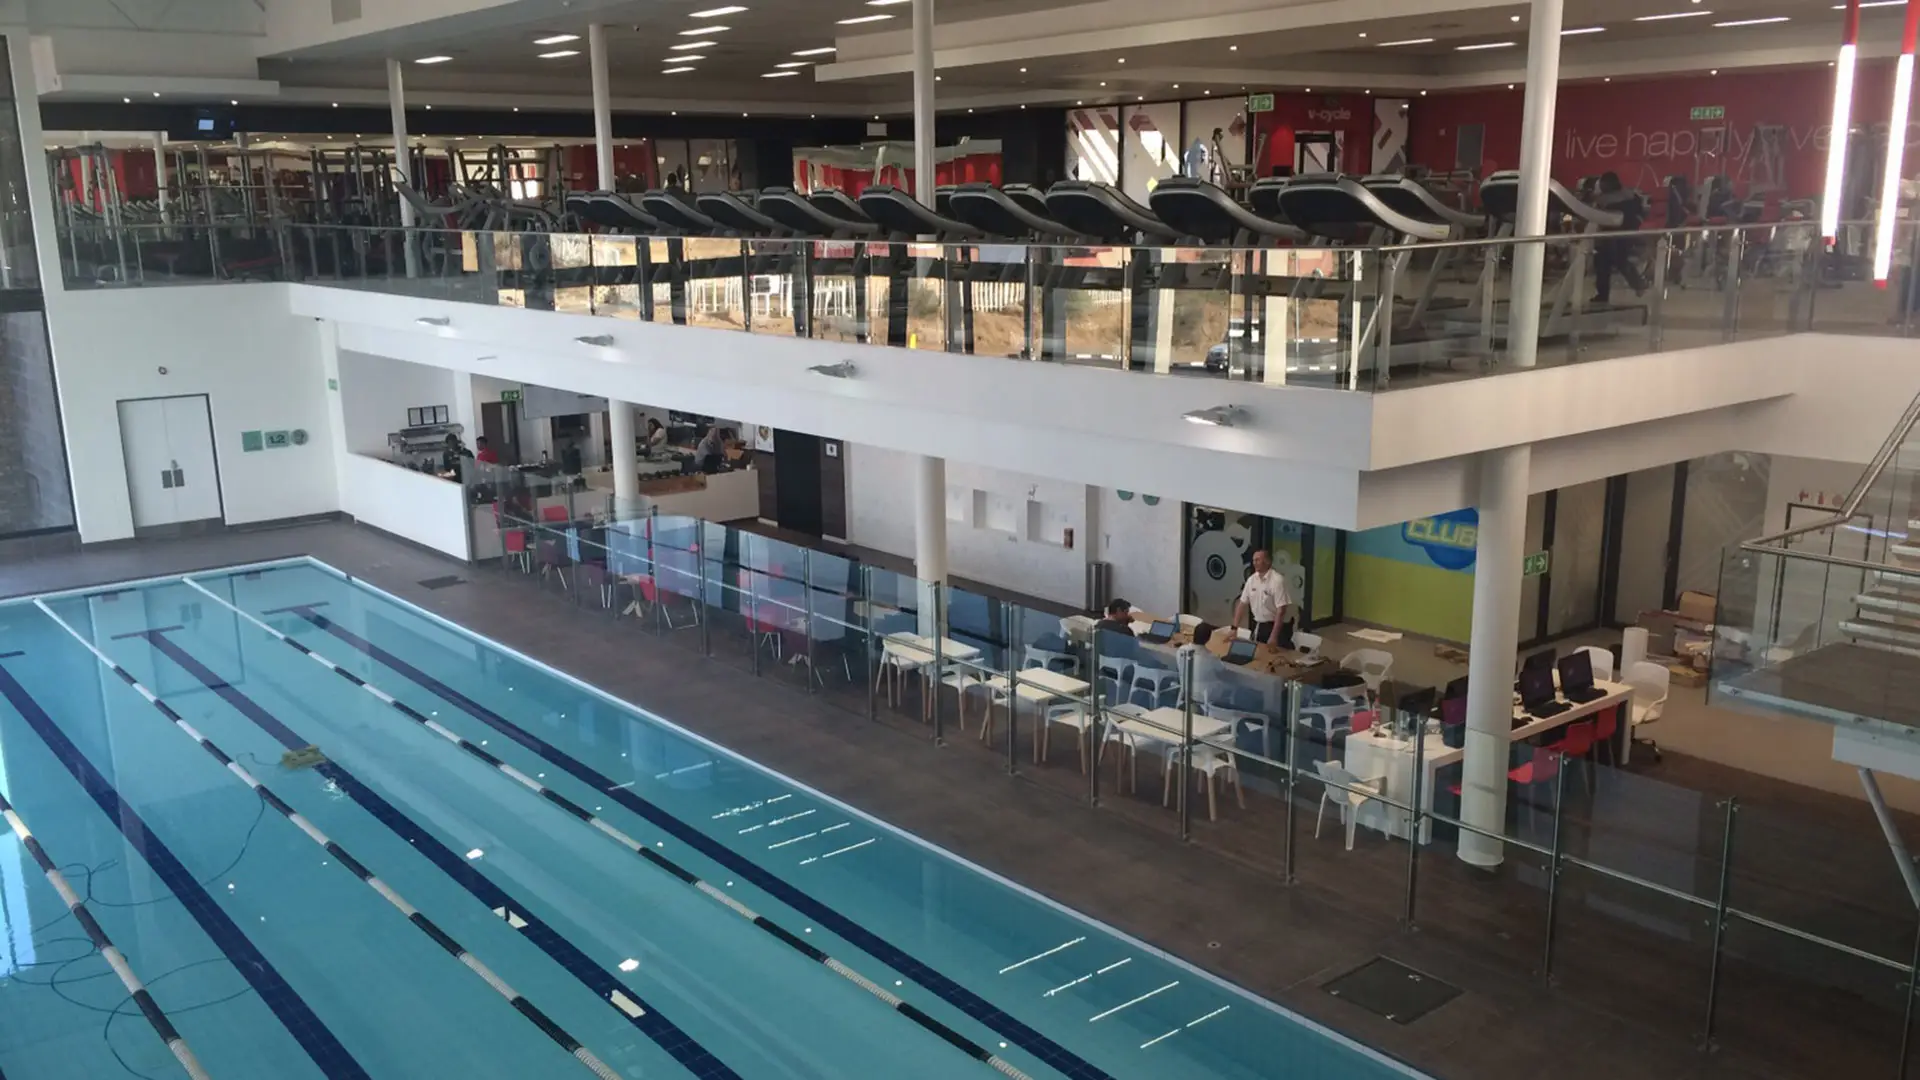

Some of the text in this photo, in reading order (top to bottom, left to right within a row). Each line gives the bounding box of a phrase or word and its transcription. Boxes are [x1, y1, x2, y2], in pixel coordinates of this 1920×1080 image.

[1565, 127, 1619, 159] live
[1625, 121, 1752, 162] haply
[1407, 518, 1477, 548] CLUB
